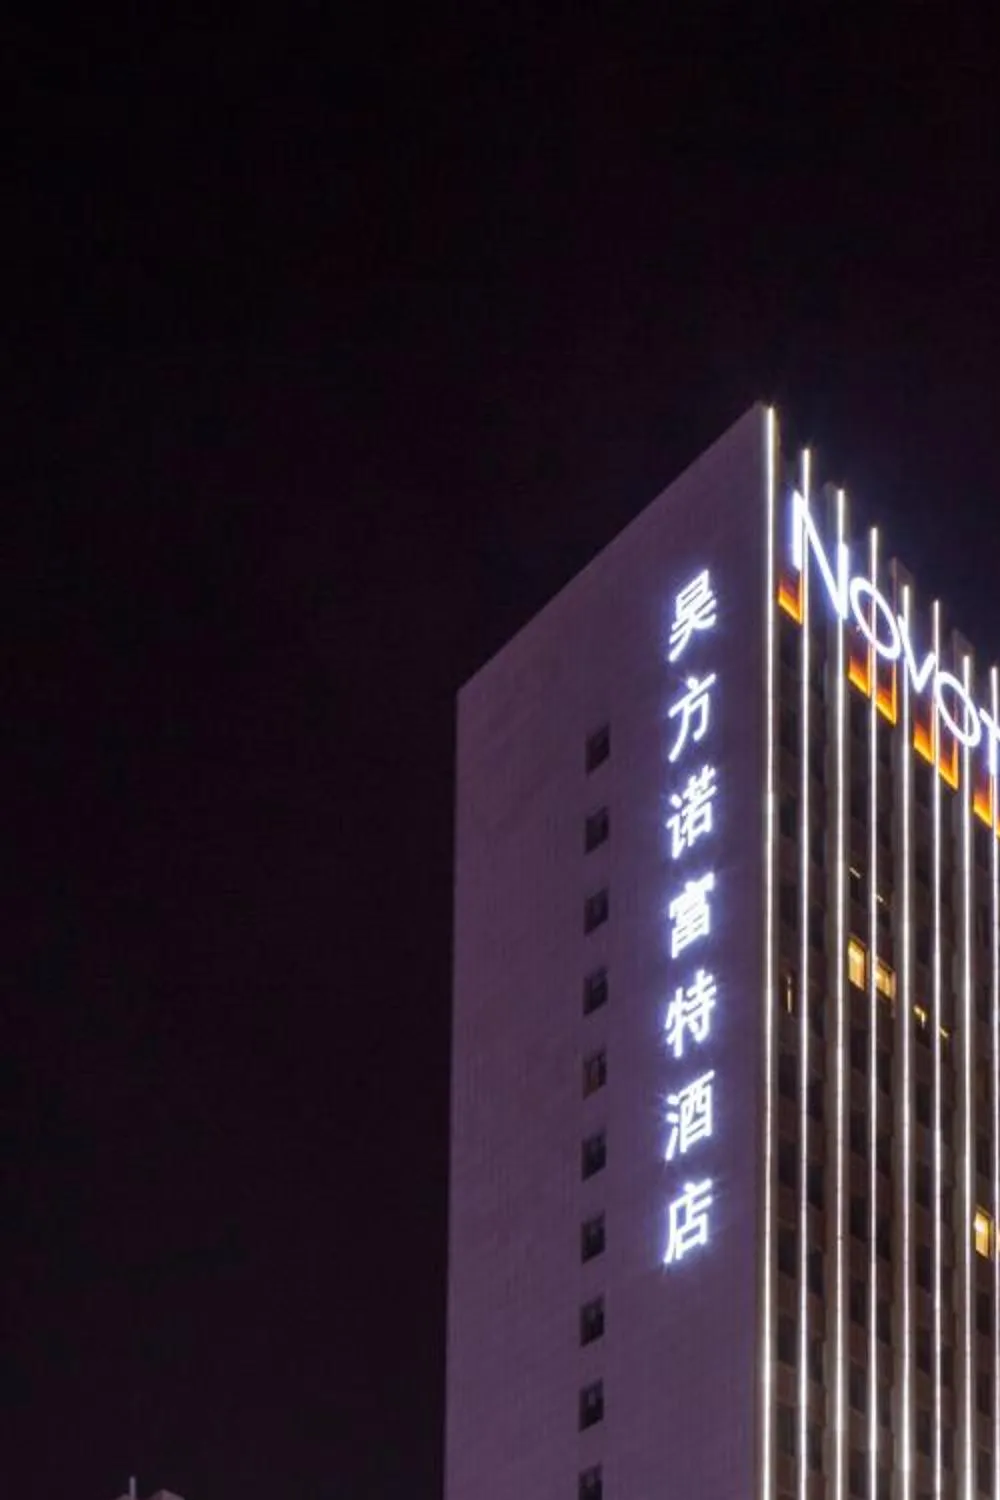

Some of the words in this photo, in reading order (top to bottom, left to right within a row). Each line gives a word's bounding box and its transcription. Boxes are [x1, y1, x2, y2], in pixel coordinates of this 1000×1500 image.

[664, 568, 718, 1265] 昊方诺富特酒店
